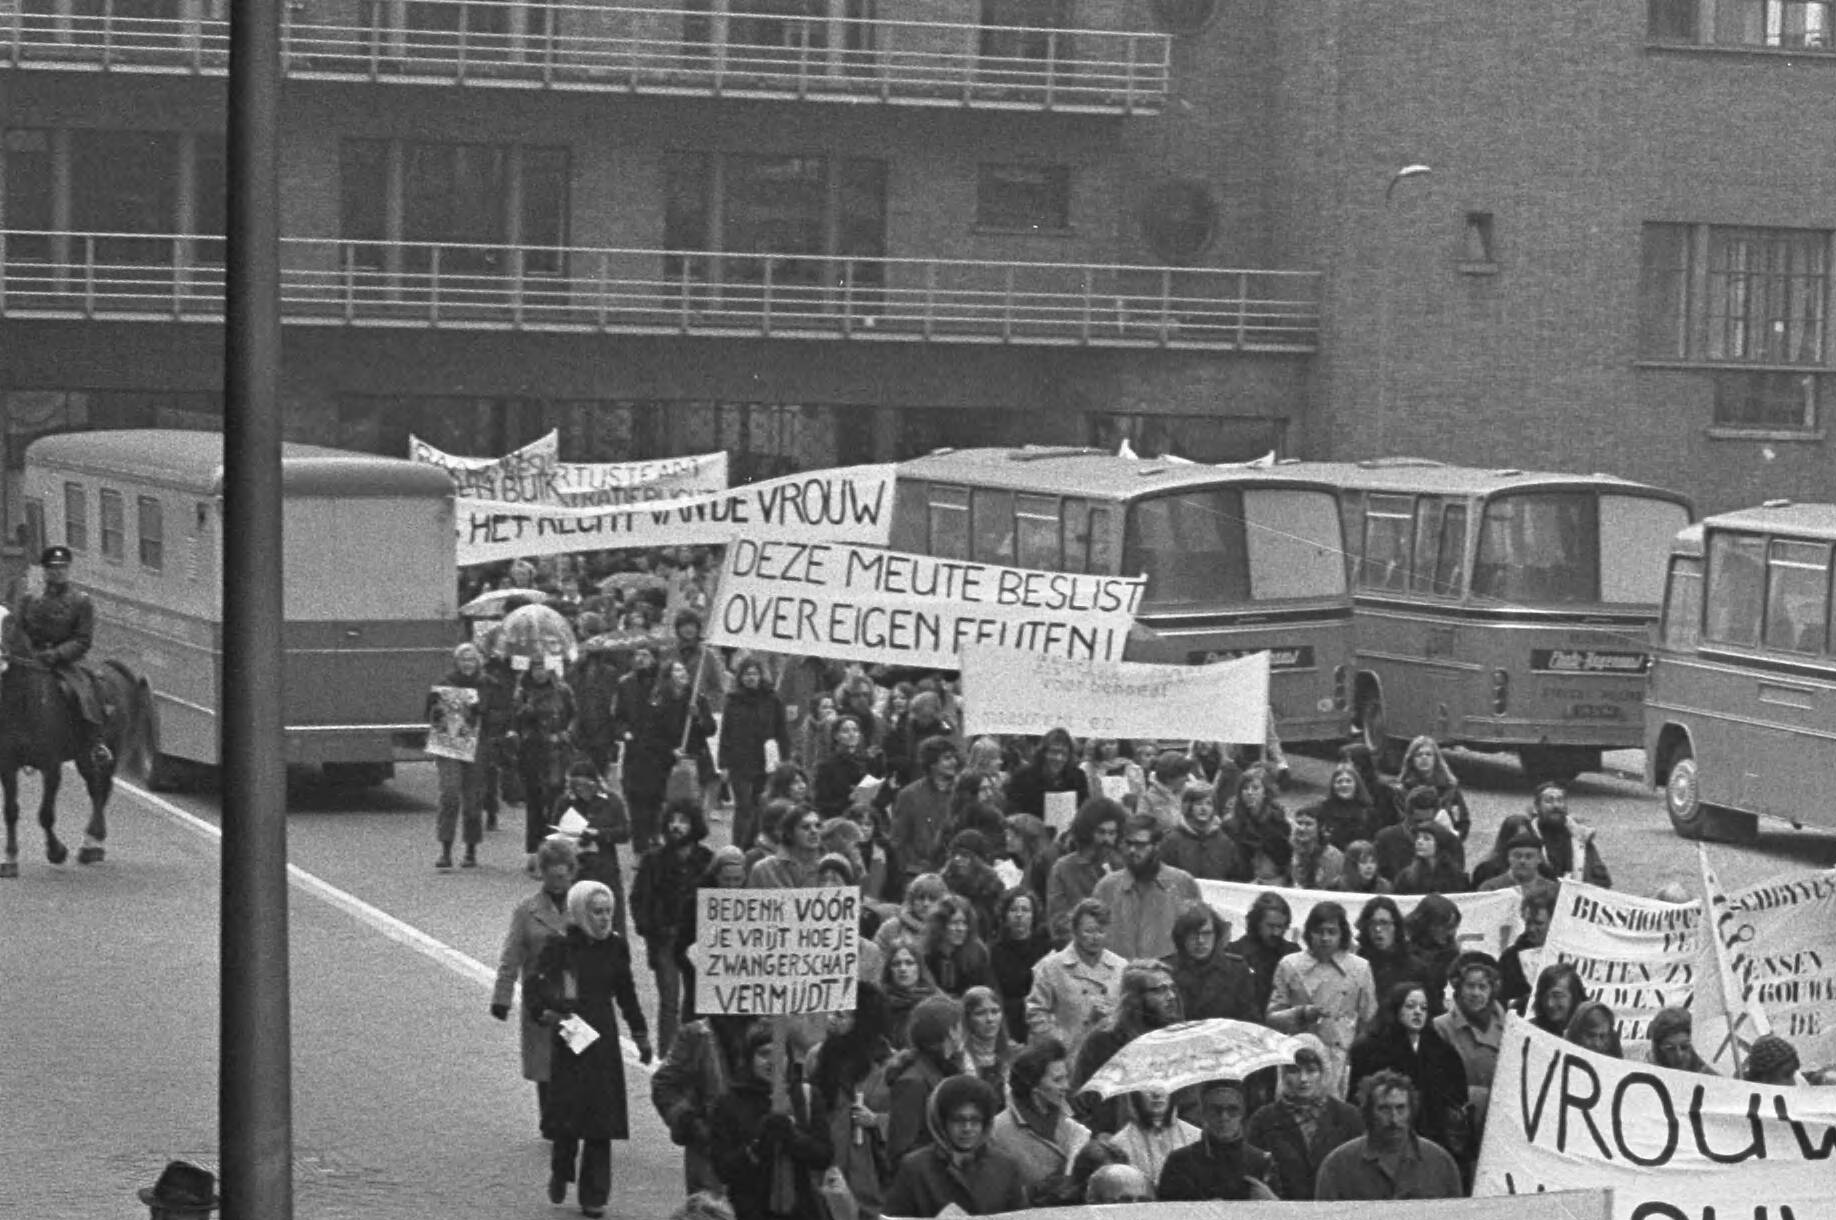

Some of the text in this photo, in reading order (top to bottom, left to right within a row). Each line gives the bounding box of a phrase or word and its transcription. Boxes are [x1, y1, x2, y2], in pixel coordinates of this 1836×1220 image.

[469, 511, 531, 544] HET
[757, 478, 886, 527] VROUW
[732, 539, 1148, 615] DEZE MEUTE BESLIST
[724, 593, 820, 641] OVER
[829, 602, 940, 652] EIGEN
[707, 896, 785, 922] BEDENK
[708, 927, 731, 949] JE
[706, 953, 857, 977] ZWANGERSCHAP
